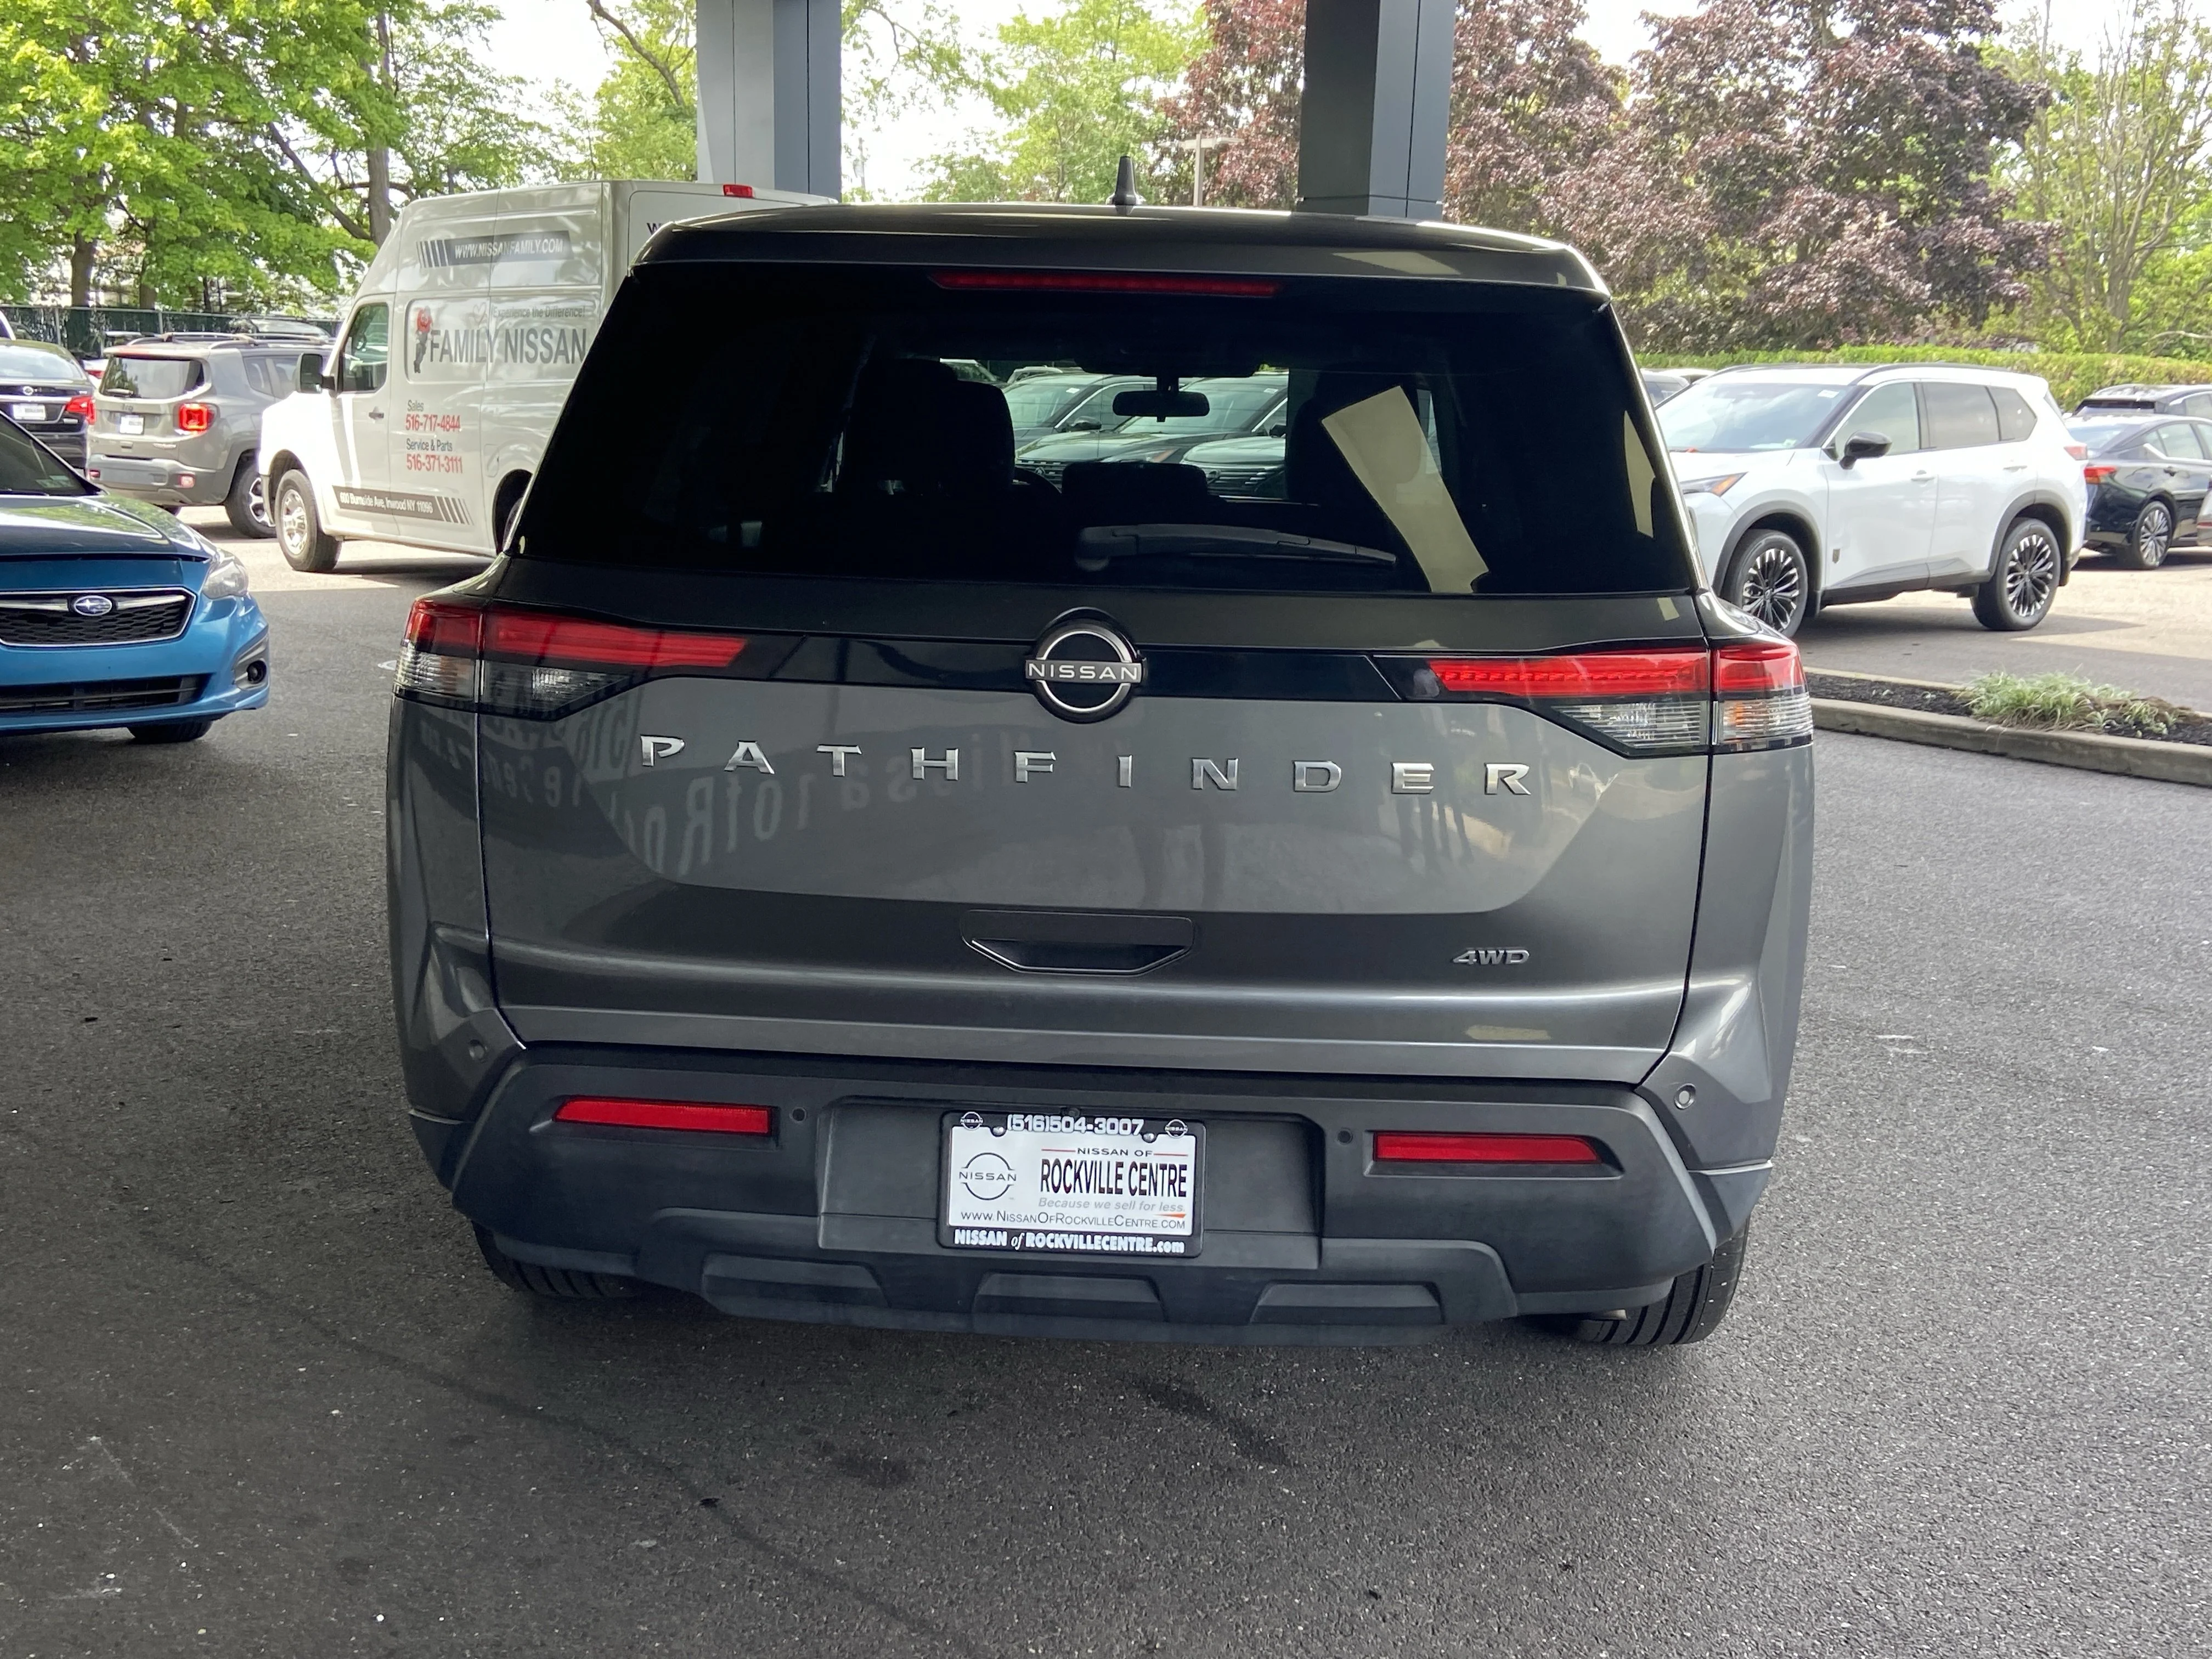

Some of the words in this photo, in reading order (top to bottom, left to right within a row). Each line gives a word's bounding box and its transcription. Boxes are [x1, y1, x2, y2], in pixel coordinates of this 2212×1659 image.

[455, 239, 563, 259] WWW.NISSANFAMILY.COM
[532, 306, 543, 318] the
[545, 306, 585, 318] Difference!
[430, 329, 499, 363] FAMILY
[505, 329, 586, 364] NISSAN
[407, 399, 424, 411] Sales
[405, 414, 461, 432] 516-717-4844
[406, 438, 429, 451] Service
[431, 439, 436, 451] &
[437, 439, 453, 452] Parts
[407, 454, 463, 473] 516-371-3111
[407, 500, 415, 511] NY
[1029, 663, 1137, 680] NISSAN
[640, 734, 1532, 795] PATHFINDER
[1453, 949, 1530, 966] 4WD
[1007, 1114, 1144, 1136] (516)504-3007
[1077, 1148, 1128, 1156] NISSAN
[959, 1171, 1017, 1182] NISSAN
[1041, 1158, 1124, 1194] ROCKVILLE
[1128, 1161, 1187, 1197] CENTRE
[1039, 1197, 1090, 1209] Because
[1094, 1201, 1111, 1209] we
[1114, 1200, 1136, 1210] sell
[1139, 1201, 1156, 1211] for
[1159, 1201, 1186, 1212] less.
[955, 1228, 1007, 1246] NISSAN
[1011, 1232, 1024, 1250] of
[1025, 1232, 1185, 1254] ROCKVILLECENTRE.com
